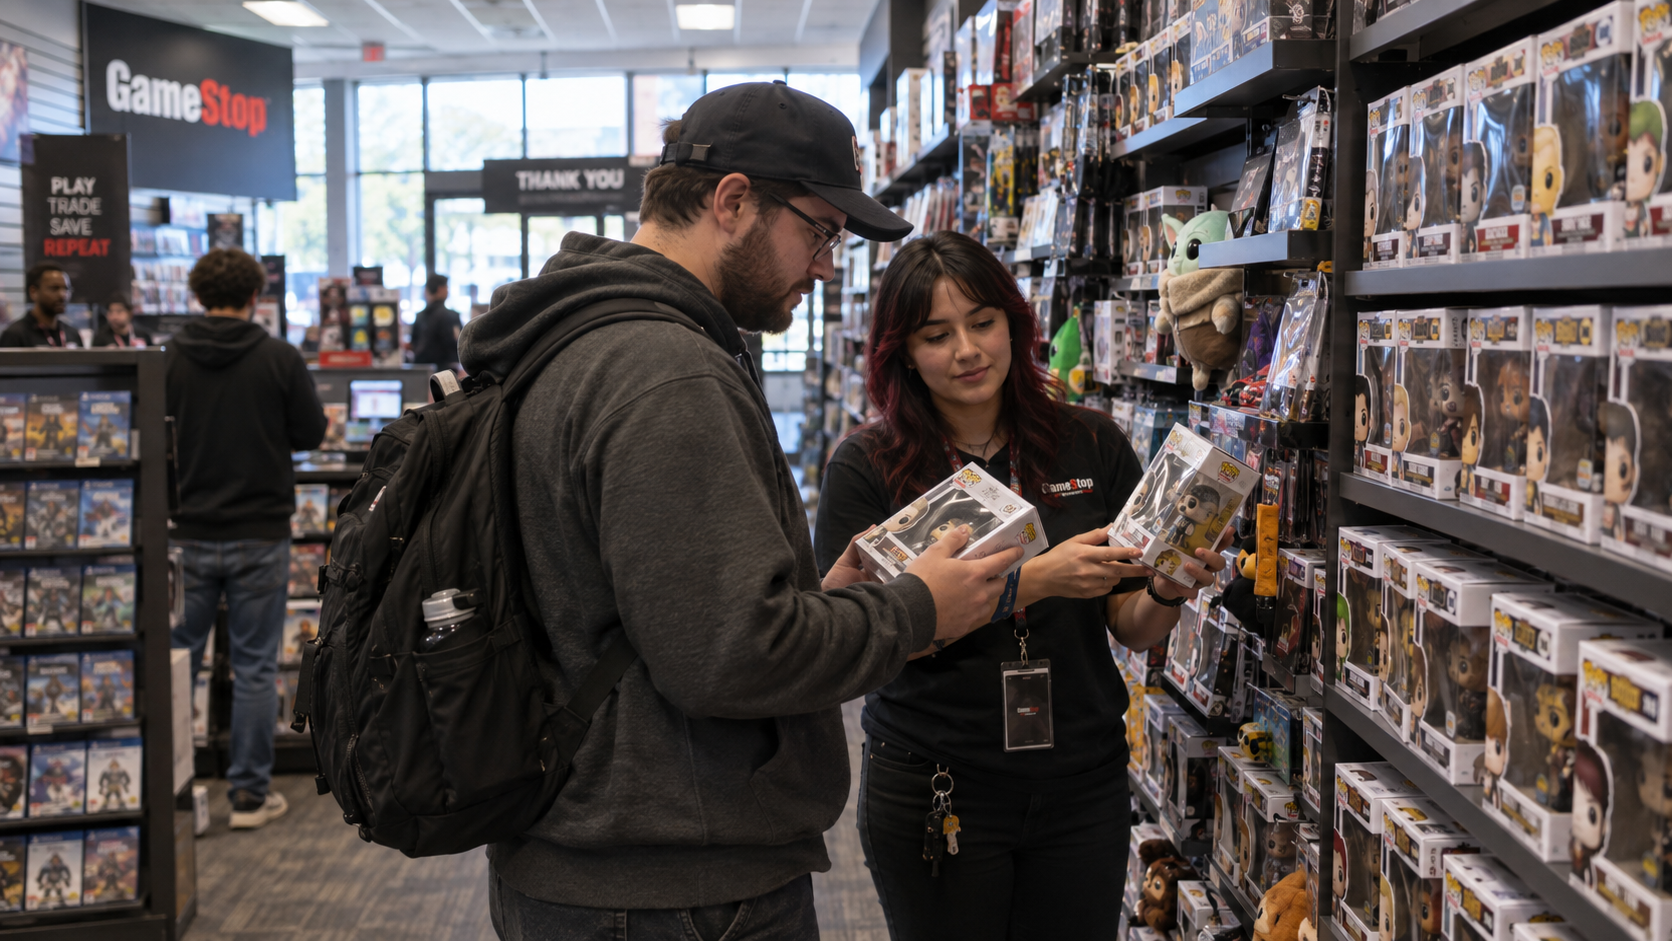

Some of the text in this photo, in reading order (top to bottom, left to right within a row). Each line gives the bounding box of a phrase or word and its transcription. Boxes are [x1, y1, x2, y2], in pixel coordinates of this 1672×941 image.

[106, 58, 268, 137] GameStop
[50, 176, 96, 195] PLAY
[516, 168, 625, 190] THANK YOU
[47, 197, 102, 216] TRADE
[50, 218, 93, 236] SAVE
[43, 238, 111, 257] REPEAT
